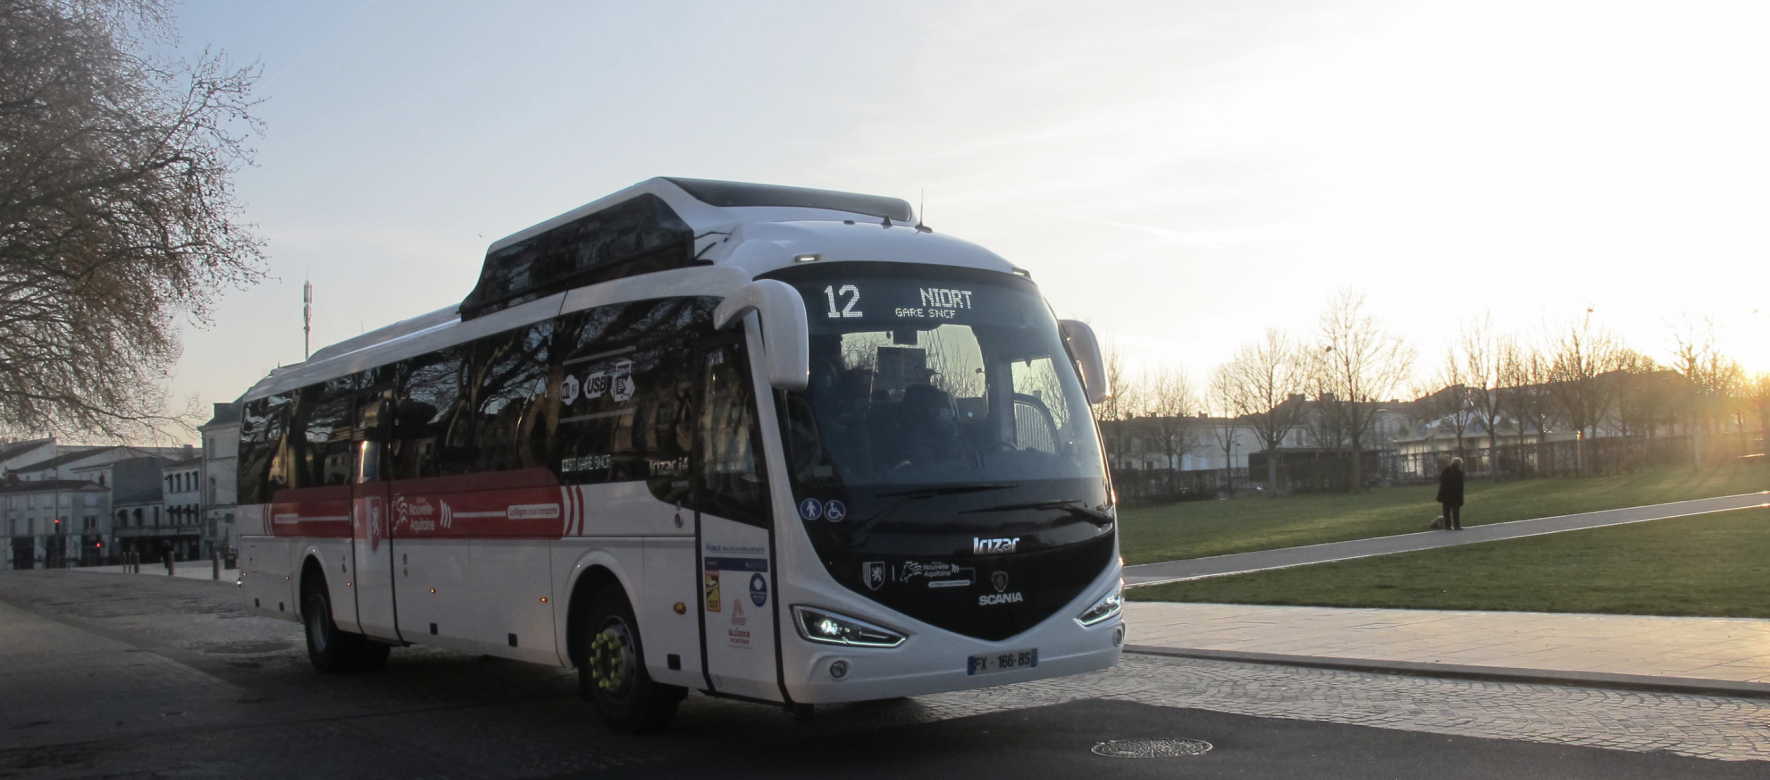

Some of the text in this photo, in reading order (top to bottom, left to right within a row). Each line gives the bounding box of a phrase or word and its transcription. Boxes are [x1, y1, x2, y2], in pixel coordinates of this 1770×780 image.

[824, 285, 863, 318] 12
[919, 287, 972, 309] NIORT
[895, 307, 956, 318] GARE SNCF
[587, 376, 607, 394] USB
[409, 502, 435, 515] Nouvelle-
[410, 517, 435, 534] Aquitaine
[973, 537, 1020, 555] Irizar
[923, 563, 952, 571] Nouvelle-
[924, 570, 951, 578] Aquitaine
[979, 592, 1023, 606] SCANIA
